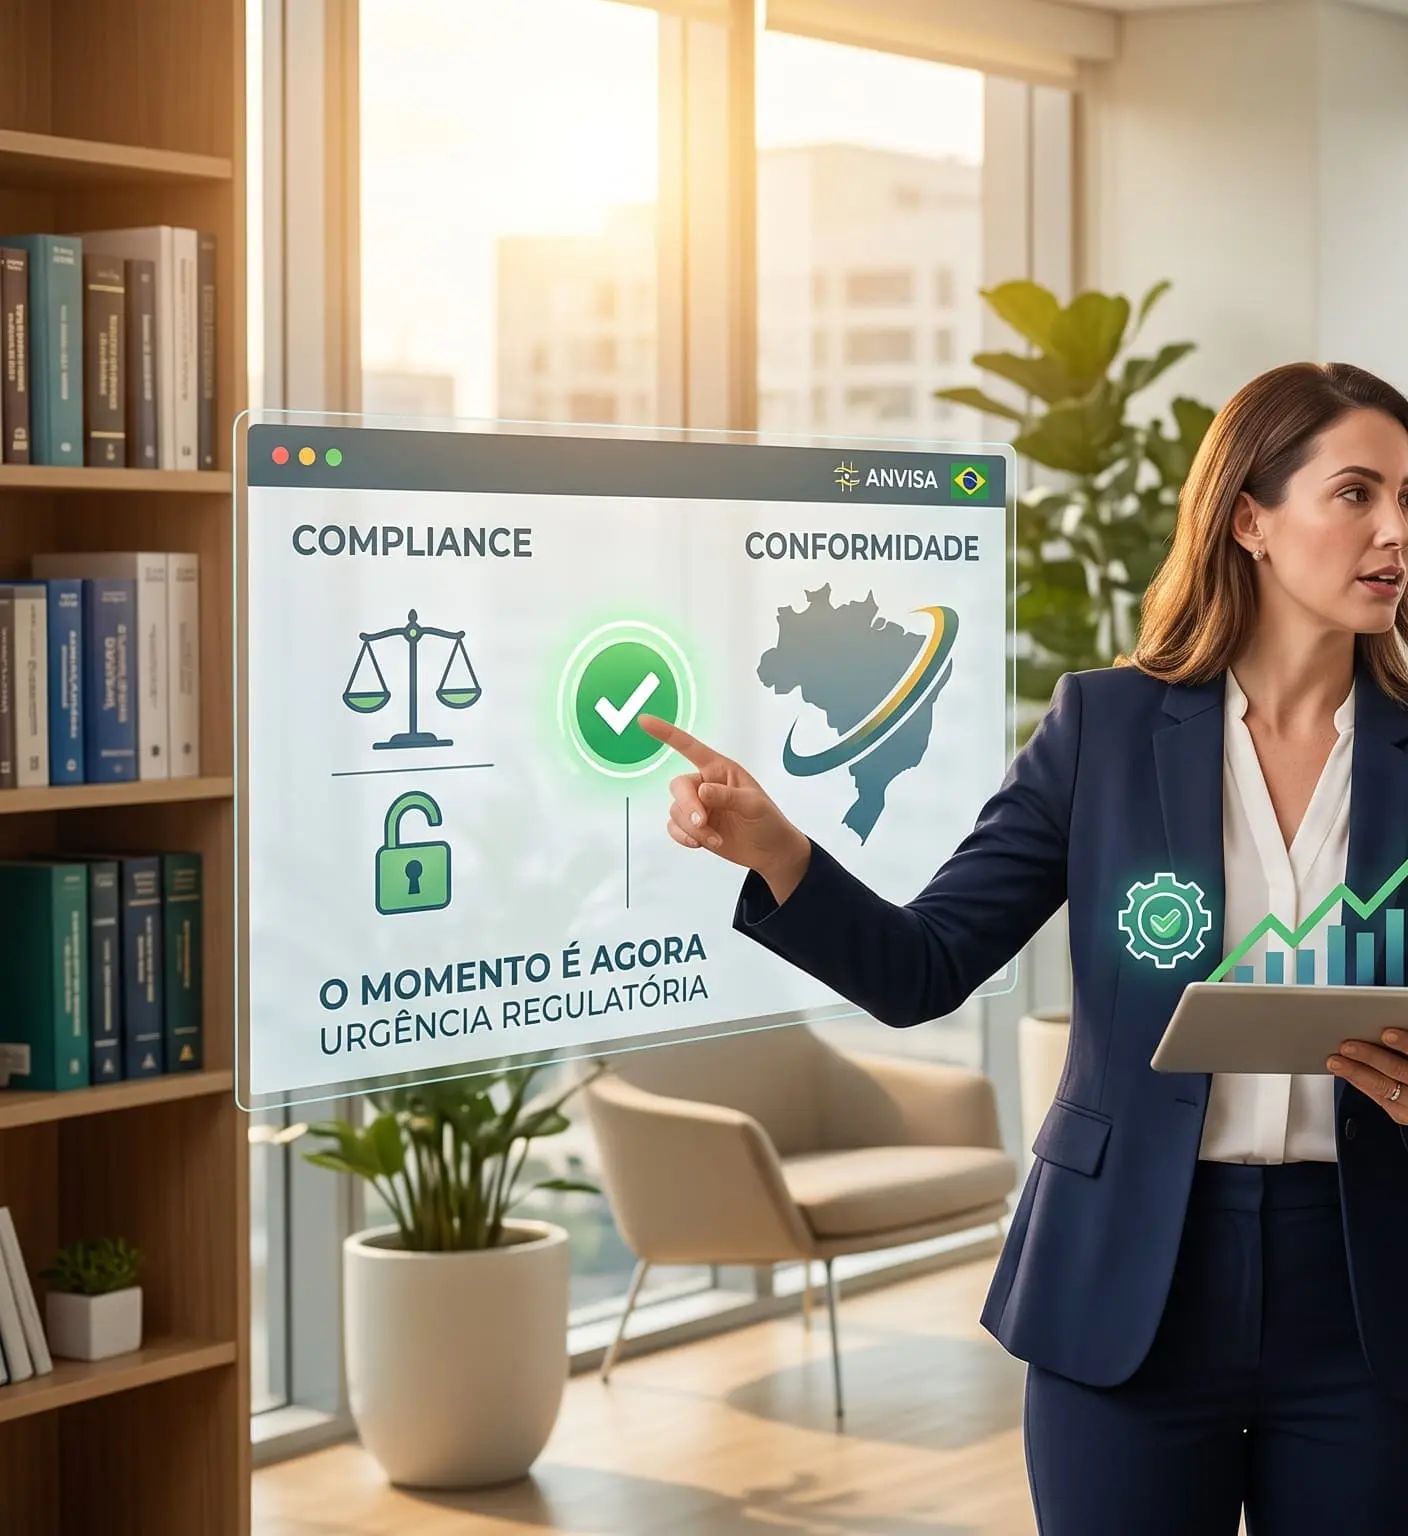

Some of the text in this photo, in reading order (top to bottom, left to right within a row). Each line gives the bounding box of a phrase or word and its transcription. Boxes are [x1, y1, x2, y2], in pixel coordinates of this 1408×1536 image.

[865, 468, 939, 489] ANVISA
[292, 524, 533, 558] COMPLIANCE
[745, 531, 980, 562] CONFORMIDADE
[319, 933, 707, 1011] O MOMENTO É AGORA
[320, 973, 709, 1056] URGÊNCIA REGULATÓRIA
